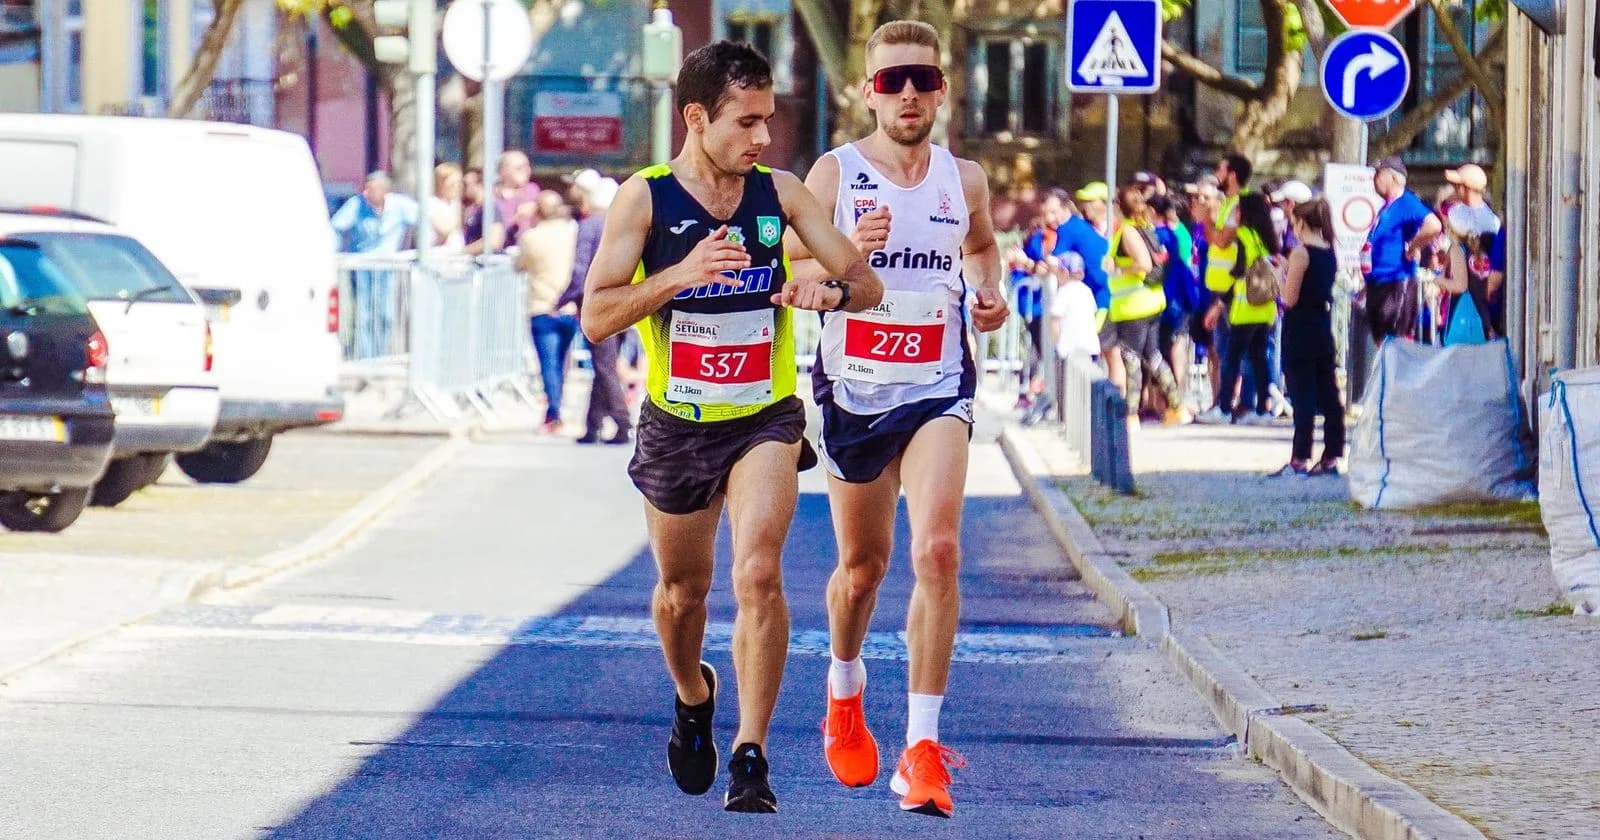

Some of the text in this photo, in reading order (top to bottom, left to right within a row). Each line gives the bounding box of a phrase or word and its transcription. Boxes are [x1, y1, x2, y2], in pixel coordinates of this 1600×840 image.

[850, 183, 879, 191] VIATOR
[855, 199, 876, 208] CPA
[929, 215, 960, 226] Marinha
[867, 246, 953, 272] arinha
[675, 323, 717, 336] SETÚBAL
[870, 330, 922, 358] 278
[699, 351, 748, 379] 537
